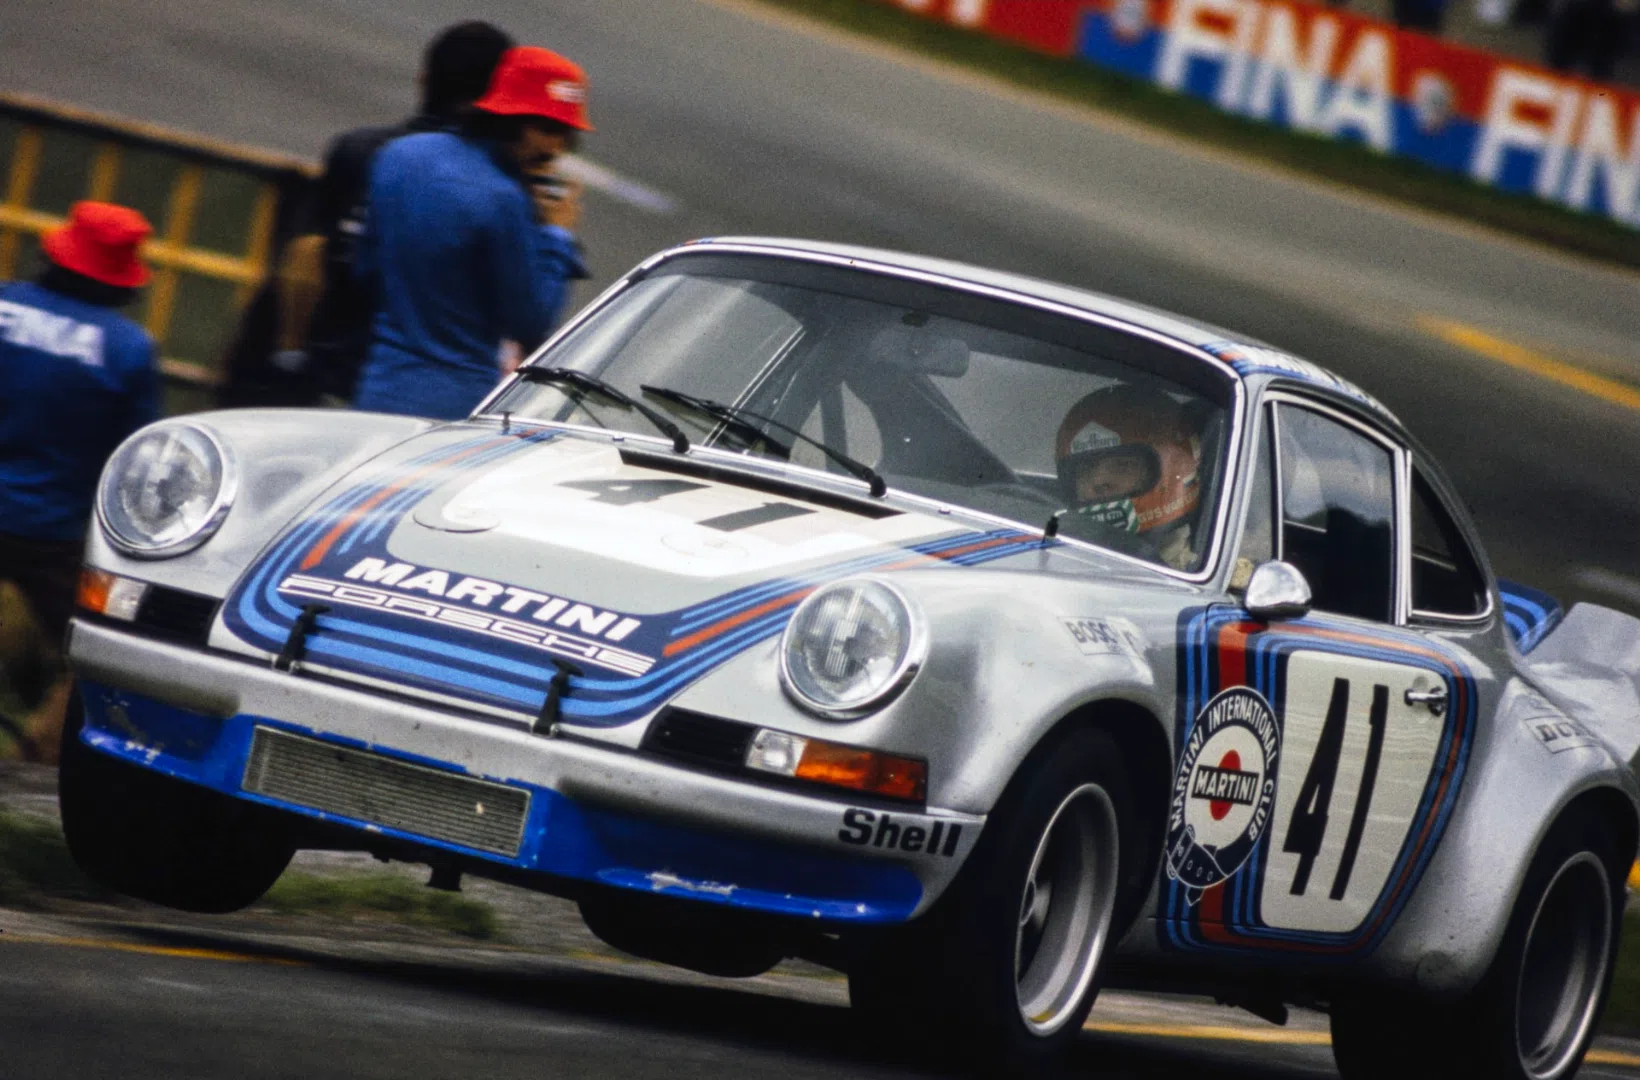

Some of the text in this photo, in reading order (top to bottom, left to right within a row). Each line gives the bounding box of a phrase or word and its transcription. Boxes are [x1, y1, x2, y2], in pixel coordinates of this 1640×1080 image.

[1156, 0, 1391, 152] FINA
[553, 479, 819, 532] 41
[276, 573, 657, 678] PORSCHE
[344, 557, 641, 642] MARTINI
[1171, 695, 1277, 841] MARTINI INTERNATIONAL CLUB
[1194, 770, 1257, 801] MARTINI
[1282, 677, 1389, 901] 41
[838, 808, 963, 857] Shell
